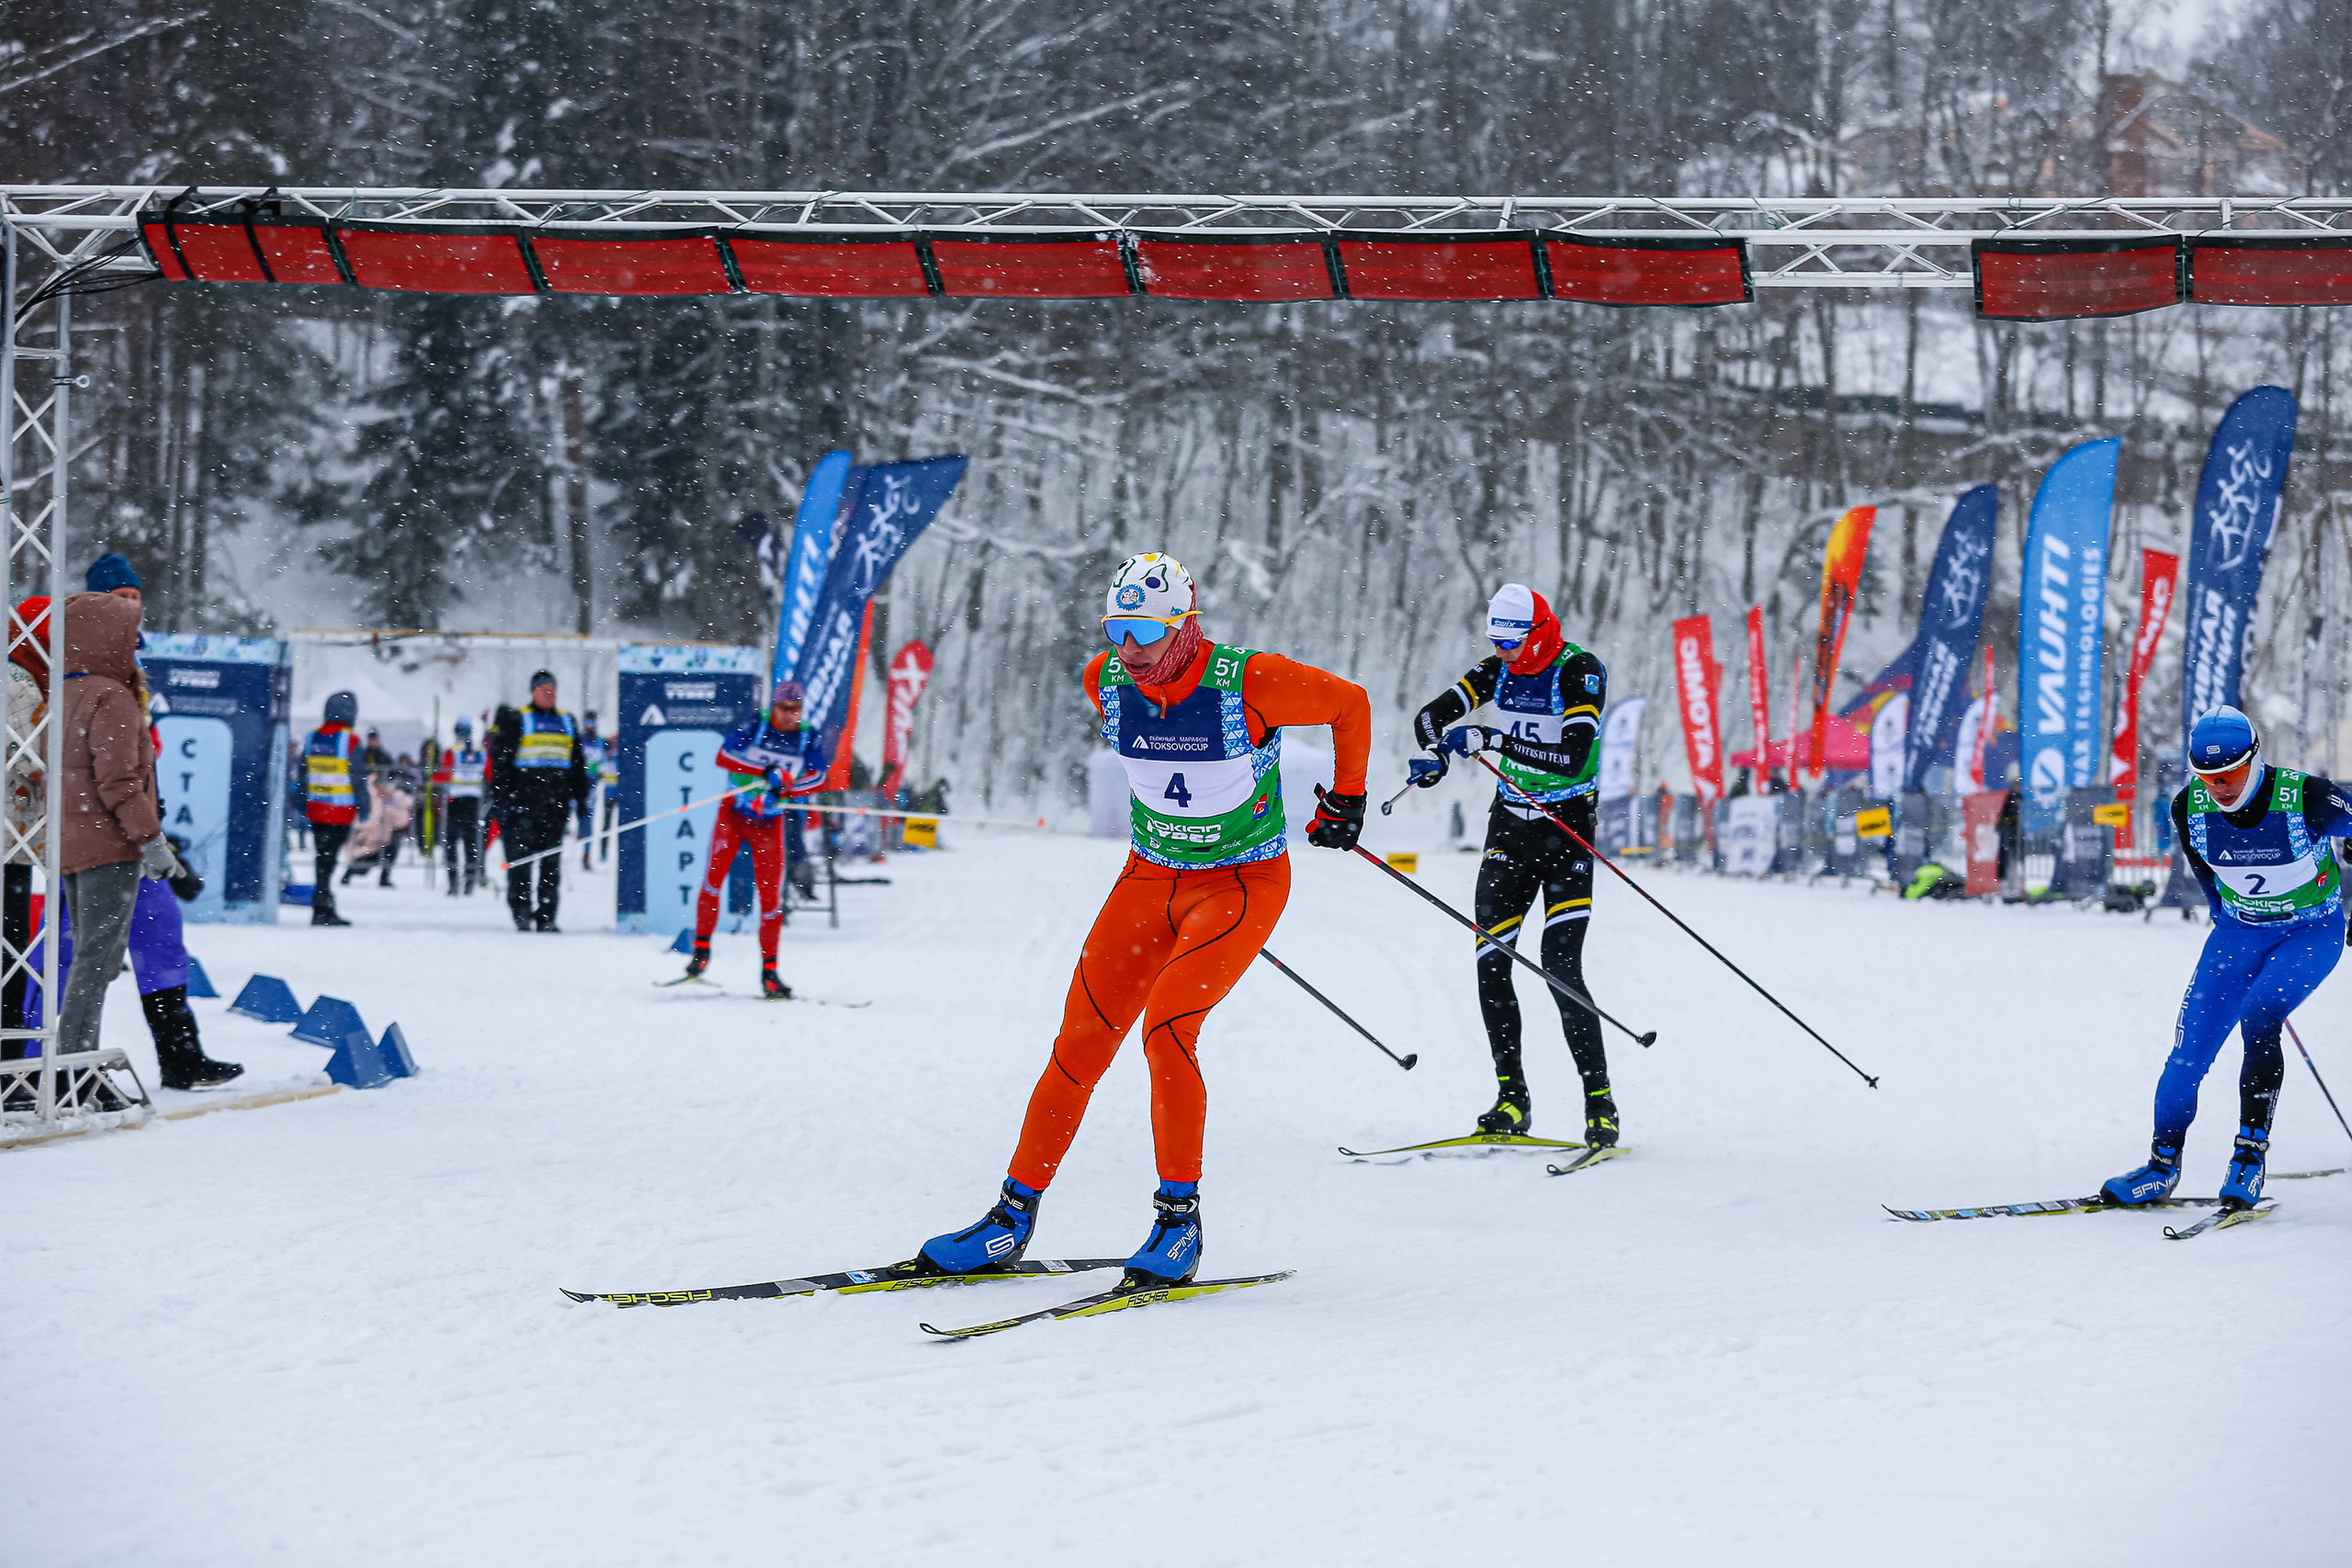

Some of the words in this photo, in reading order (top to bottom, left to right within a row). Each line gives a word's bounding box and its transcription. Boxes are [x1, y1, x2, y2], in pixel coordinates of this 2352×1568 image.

[2038, 533, 2071, 735] VAUHTI
[2075, 547, 2101, 731] TECHNOLOGIES
[1108, 657, 1127, 673] 5
[1214, 658, 1239, 679] 51
[1111, 674, 1125, 682] KM
[1216, 678, 1230, 687] KM
[1510, 720, 1543, 743] 45
[1150, 742, 1208, 751] TOKSOVOCUP
[1548, 752, 1570, 764] TEAM
[1163, 773, 1192, 808] 4
[2278, 787, 2299, 803] 51
[676, 751, 695, 906] СТАРТ
[2233, 852, 2281, 861] TOKSOVOCUP
[2245, 874, 2270, 896] 2
[1167, 1224, 1198, 1260] SPINE
[1126, 1291, 1170, 1307] FISCHER
